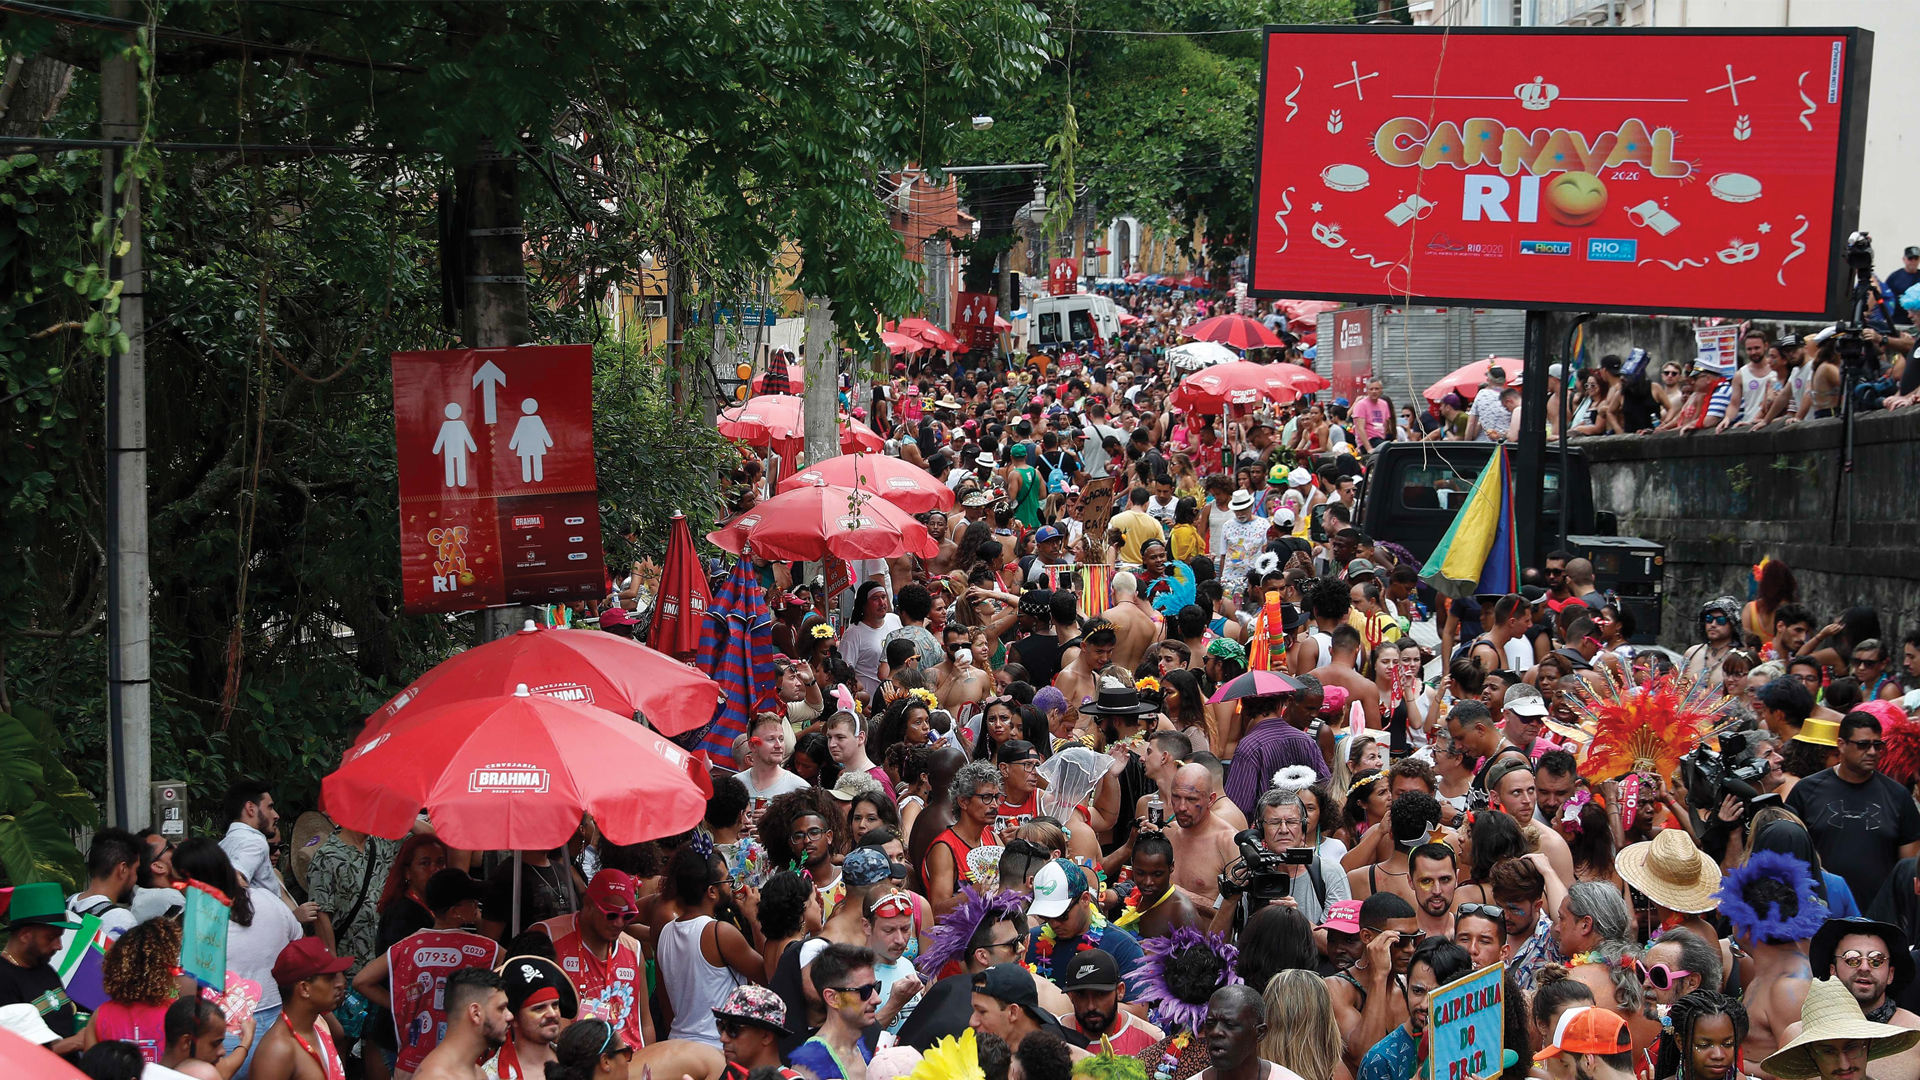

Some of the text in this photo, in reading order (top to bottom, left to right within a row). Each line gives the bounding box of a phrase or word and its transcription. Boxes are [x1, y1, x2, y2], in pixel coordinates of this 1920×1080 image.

[1373, 115, 1692, 178] CARNAVAL
[1610, 171, 1640, 181] 2020
[1535, 242, 1569, 254] Riotur
[1591, 242, 1620, 253] RIO
[515, 517, 541, 526] BRAHMA
[828, 576, 848, 593] ARTÕES
[530, 682, 577, 692] CERVEJARIA
[479, 772, 540, 786] BRAHMA
[1626, 792, 1637, 808] 10
[1337, 912, 1354, 920] ame
[465, 946, 485, 956] 2020
[417, 952, 458, 964] 07936
[1080, 964, 1095, 972] NIKE
[1433, 982, 1502, 1028] CAIPIRINHA
[1460, 1024, 1476, 1050] DO
